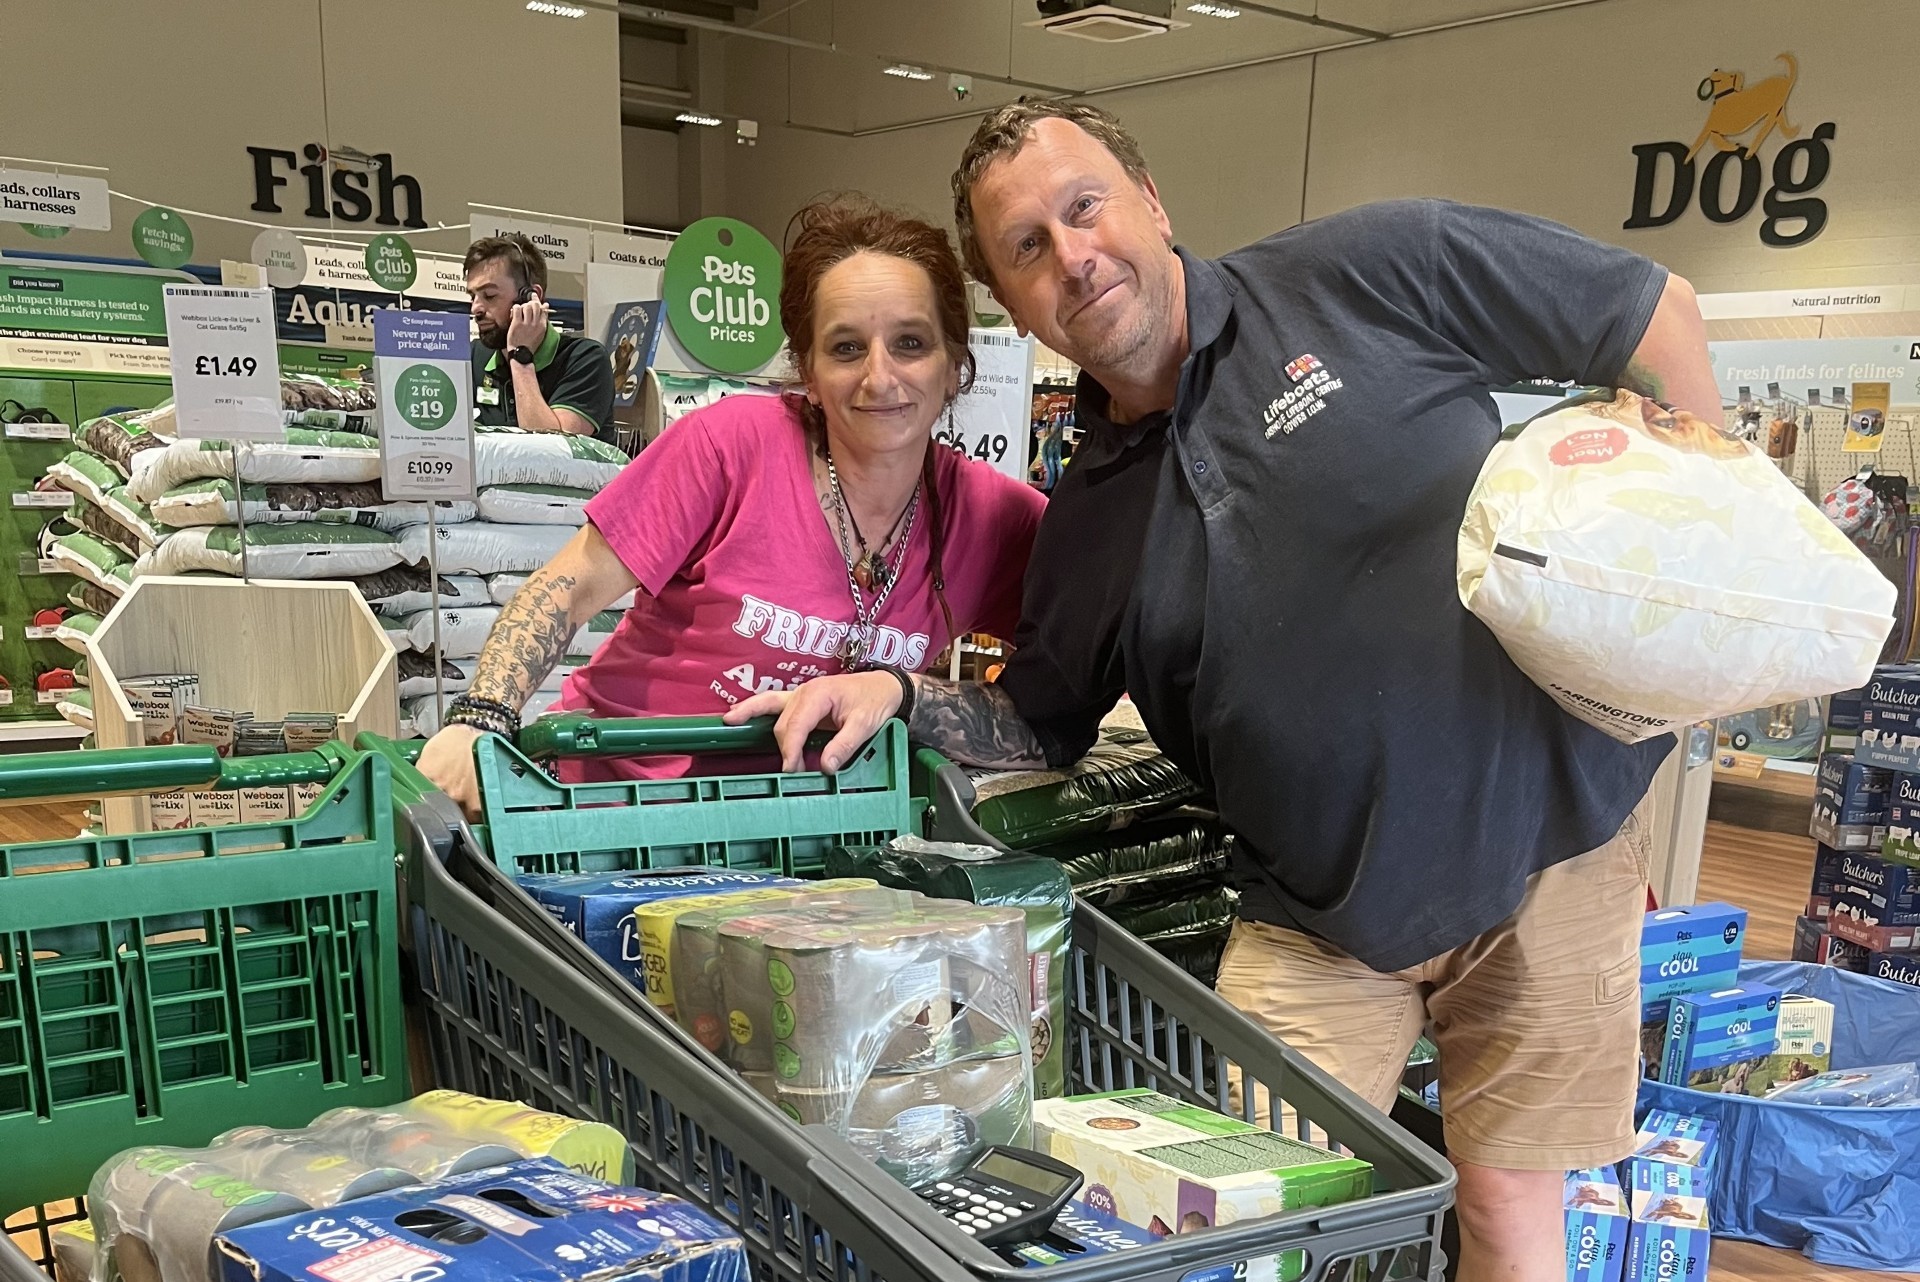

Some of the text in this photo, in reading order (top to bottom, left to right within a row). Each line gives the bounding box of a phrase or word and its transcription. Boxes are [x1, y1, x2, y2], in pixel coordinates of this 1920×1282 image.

[246, 142, 428, 229] Fish
[1623, 122, 1836, 246] Dog
[32, 186, 81, 201] collars
[3, 196, 77, 215] harnesses
[142, 226, 186, 244] Fetch the
[532, 235, 569, 247] collars
[143, 237, 183, 252] savings.
[380, 246, 402, 258] Pets
[314, 257, 366, 270] Leads, coll
[609, 251, 637, 264] Coats
[639, 254, 646, 264] &
[318, 269, 326, 277] &
[374, 258, 412, 275] Club
[701, 255, 756, 286] Pets
[436, 272, 460, 282] Coats
[17, 296, 150, 311] Impact Harness is tested to
[690, 286, 770, 327] Club
[1792, 294, 1881, 307] Natural nutrition
[30, 307, 41, 315] as
[44, 307, 69, 317] child
[70, 309, 101, 321] safety
[103, 312, 145, 322] systems.
[15, 330, 36, 338] right
[37, 332, 79, 341] extending
[79, 333, 96, 341] lead
[392, 330, 454, 341] Never pay full
[710, 326, 756, 343] Prices
[398, 341, 450, 351] price again.
[195, 355, 257, 376] £1.49
[1726, 363, 1905, 381] Fresh finds for felines
[989, 373, 1003, 382] Wild
[1005, 376, 1019, 385] Bird
[1314, 378, 1343, 397] CENTRE
[411, 385, 440, 396] 2 for
[1263, 369, 1330, 424] Lifeboats
[410, 400, 444, 419] £19
[1283, 411, 1307, 434] COWES
[1566, 431, 1608, 446] No.1
[1567, 446, 1613, 461] Meat
[408, 461, 453, 474] £10.99
[777, 661, 798, 672] of
[1870, 682, 1920, 706] Butcher
[1549, 683, 1668, 728] HARRINGTONS
[187, 719, 229, 730] Webbox
[193, 792, 235, 800] Webbox
[243, 792, 284, 800] Webbox
[1842, 857, 1884, 886] Butcher's
[1677, 930, 1693, 941] Pets
[1672, 951, 1693, 961] stay
[1037, 955, 1047, 983] TURKEY
[1660, 957, 1699, 977] COOL
[1672, 1005, 1685, 1040] COOL
[1727, 1021, 1752, 1036] COOL
[1089, 1191, 1111, 1209] 90%
[315, 1241, 390, 1272] REDUCED
[1577, 1226, 1596, 1271] COOL
[1588, 1238, 1601, 1263] stay
[1605, 1242, 1616, 1261] Pets
[1669, 1252, 1680, 1276] stay
[1686, 1257, 1696, 1275] Pets
